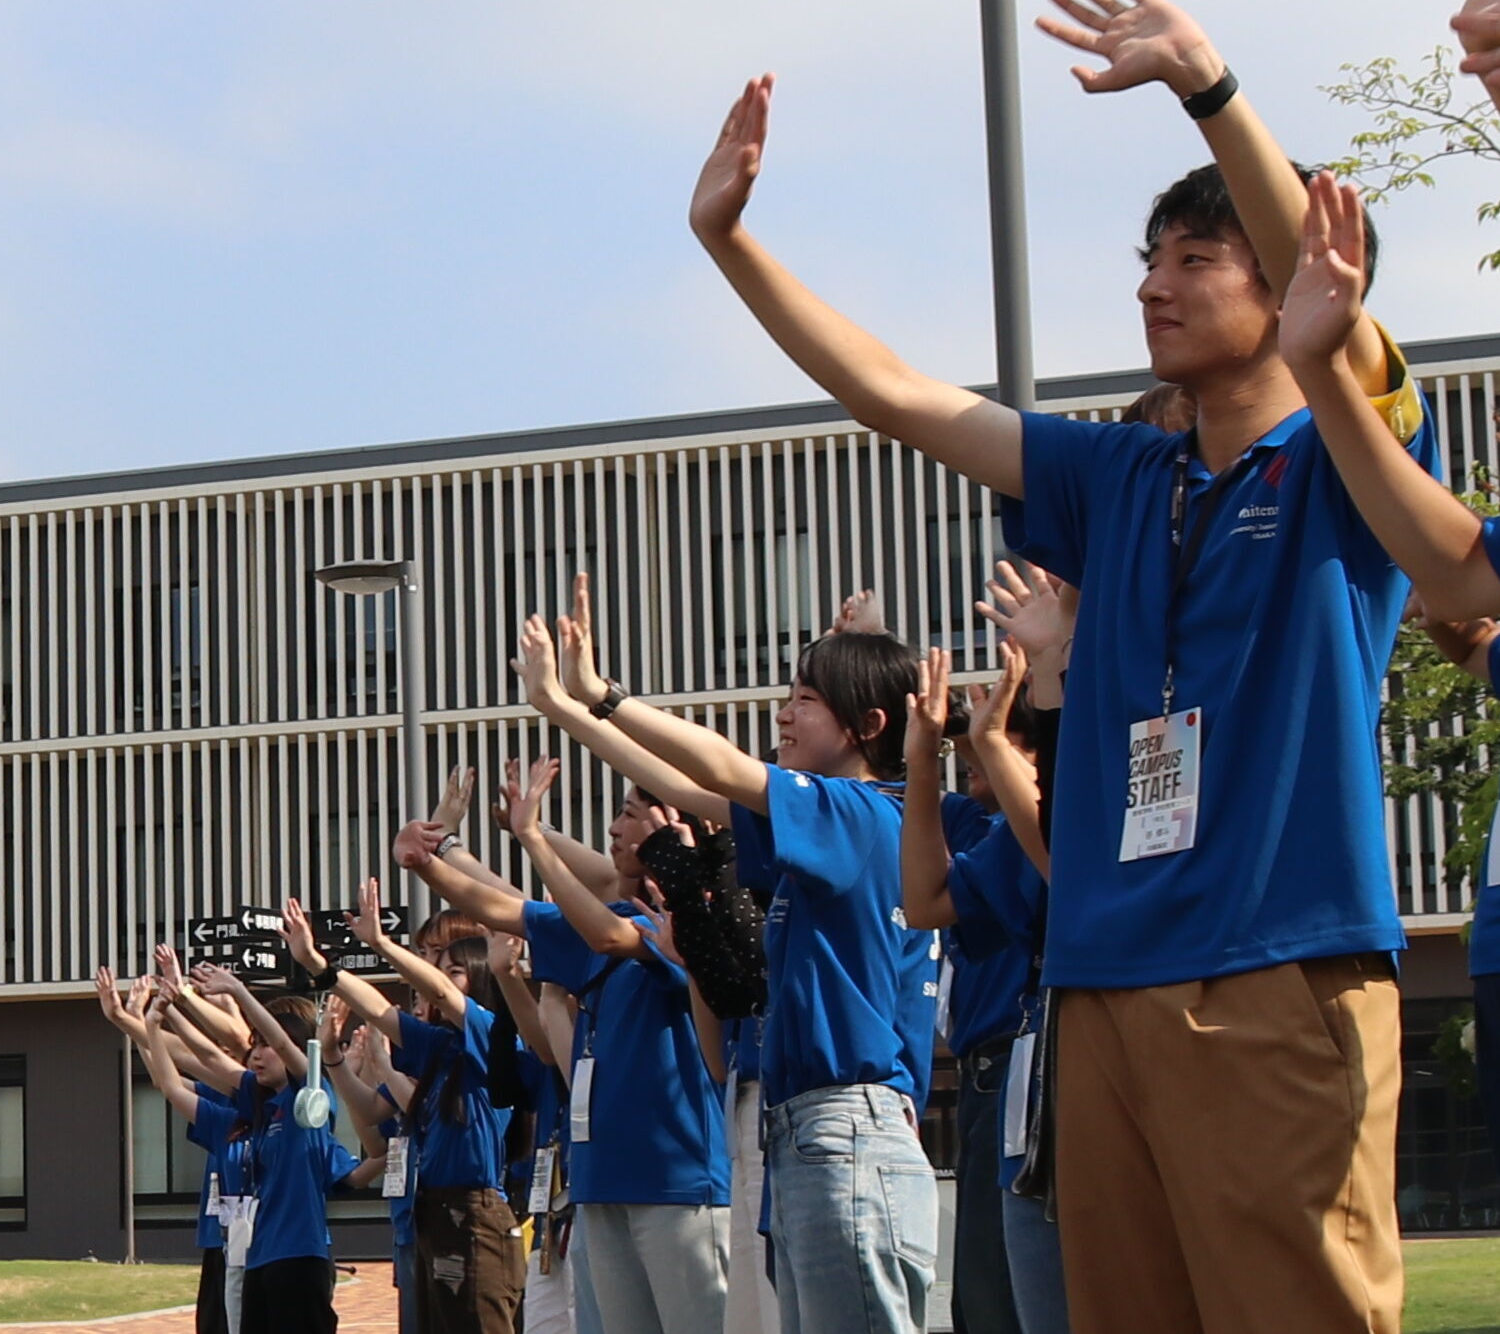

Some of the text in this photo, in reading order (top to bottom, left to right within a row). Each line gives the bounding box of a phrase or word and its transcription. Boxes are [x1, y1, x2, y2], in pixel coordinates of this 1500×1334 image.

[1130, 733, 1165, 759] OPEN
[1129, 749, 1184, 779] CAMPUS
[1127, 771, 1182, 808] STAFF
